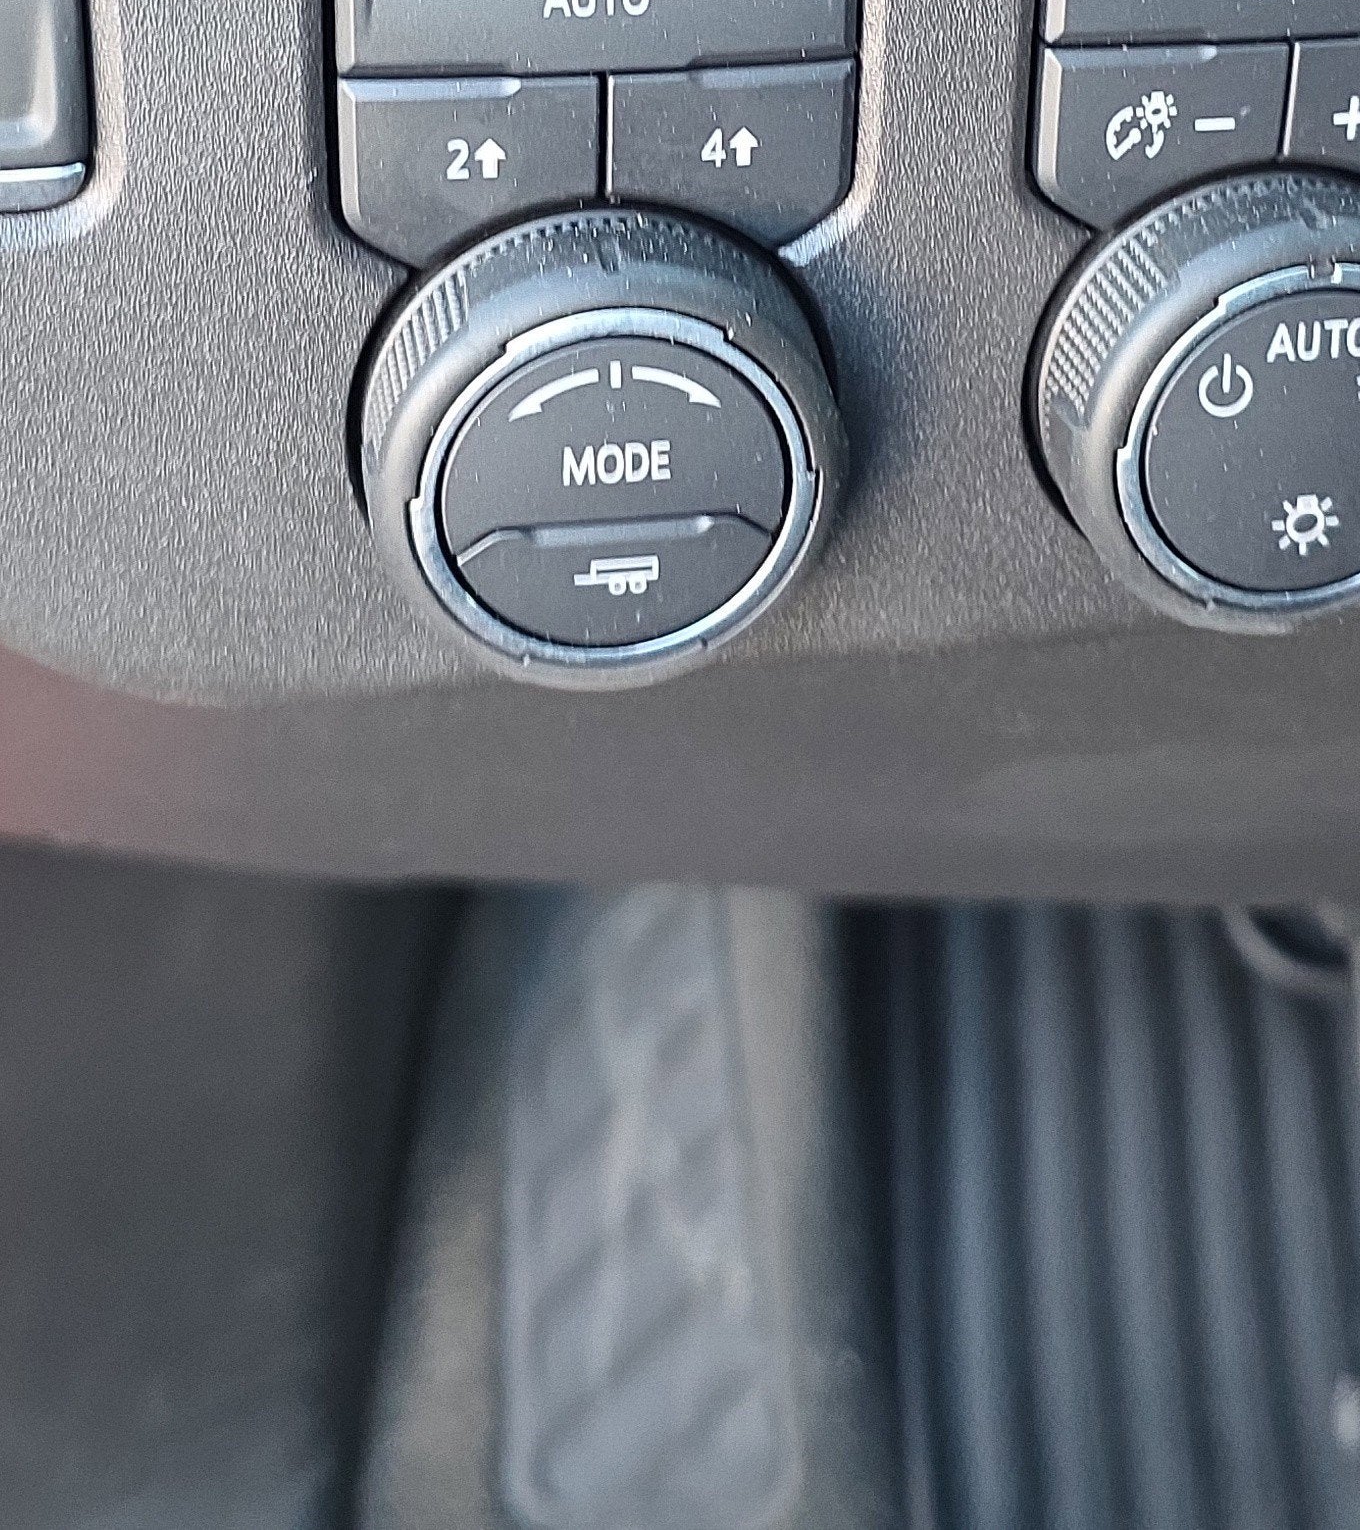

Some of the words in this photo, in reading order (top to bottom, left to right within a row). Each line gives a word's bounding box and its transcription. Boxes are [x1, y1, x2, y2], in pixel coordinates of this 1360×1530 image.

[446, 138, 471, 180] 2
[701, 127, 727, 168] 4
[562, 439, 672, 487] MODE
